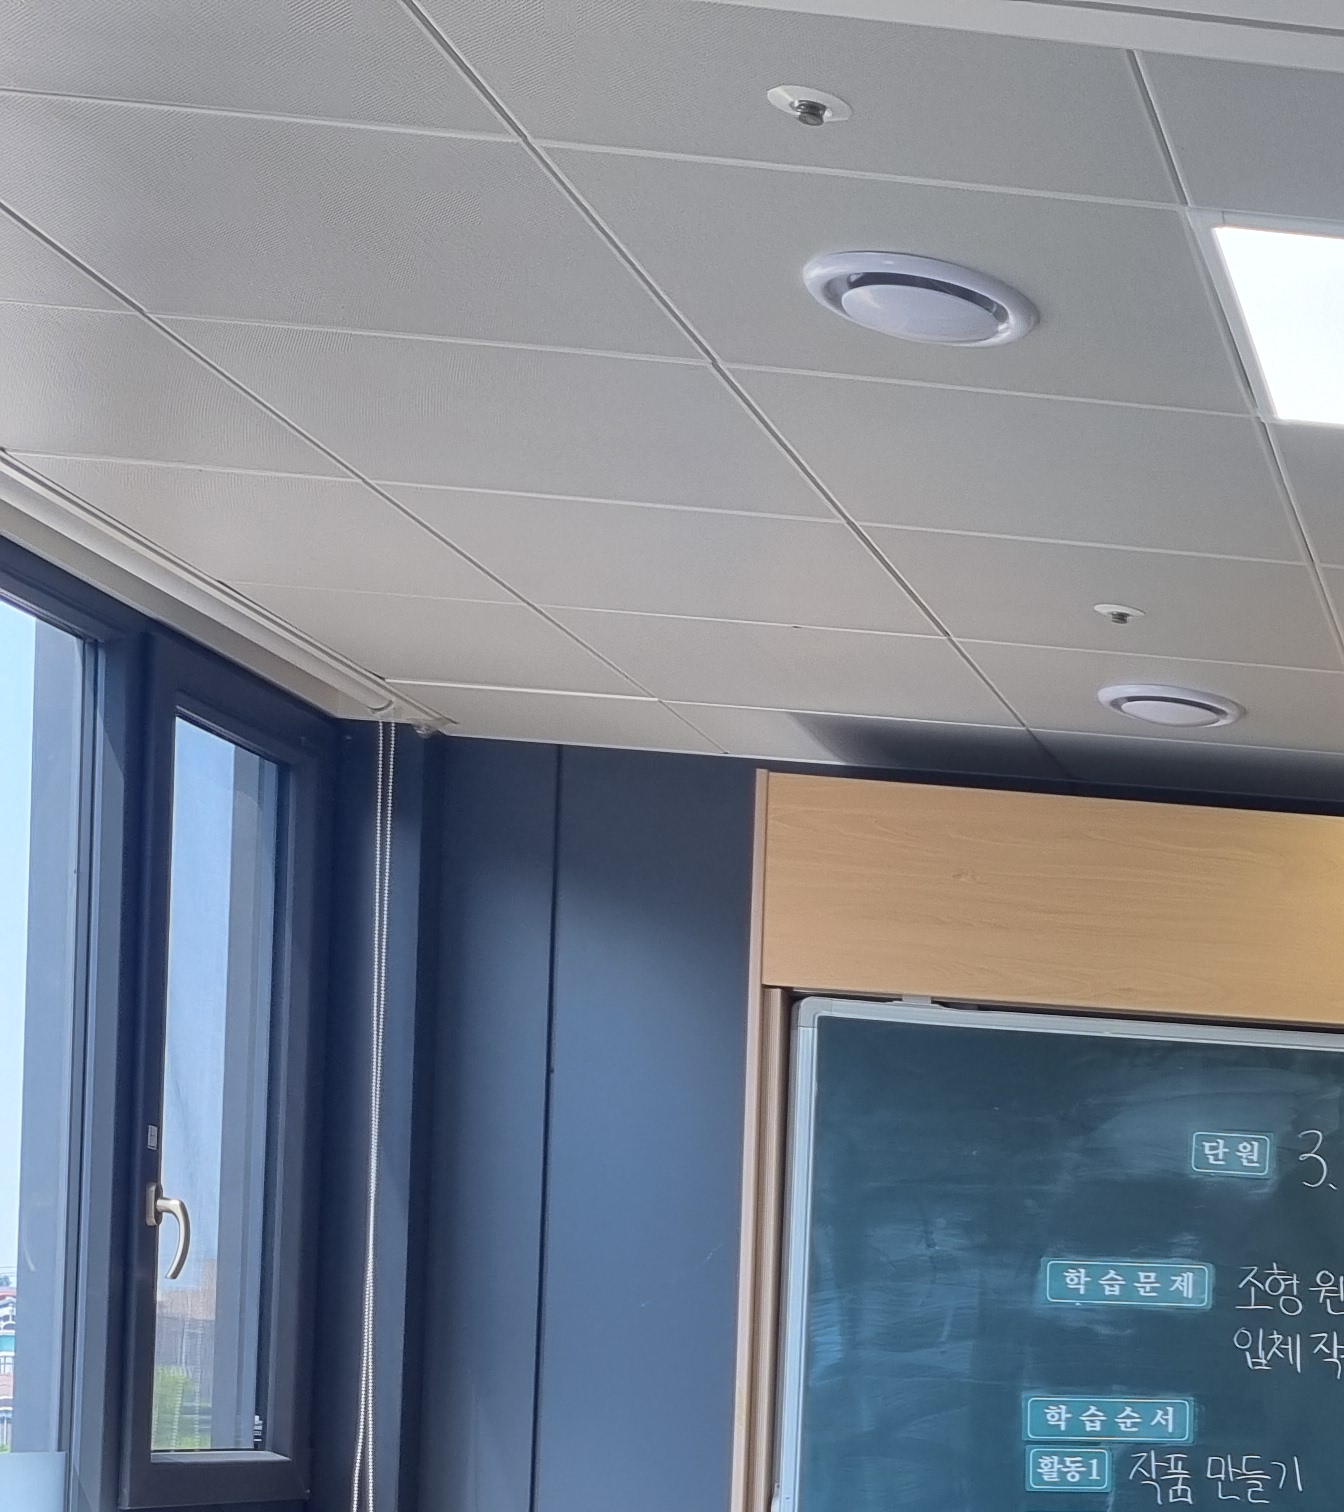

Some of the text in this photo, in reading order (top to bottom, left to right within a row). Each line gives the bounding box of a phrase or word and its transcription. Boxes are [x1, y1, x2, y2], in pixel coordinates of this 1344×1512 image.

[1202, 1138, 1261, 1168] 단원
[1298, 1129, 1338, 1190] 3.
[1063, 1268, 1195, 1300] 학습문제
[1236, 1262, 1303, 1316] 조형
[1233, 1328, 1300, 1373] 입체
[1043, 1404, 1175, 1433] 학습순서
[1037, 1455, 1101, 1482] 활동1
[1128, 1450, 1303, 1505] 작품 만들기
